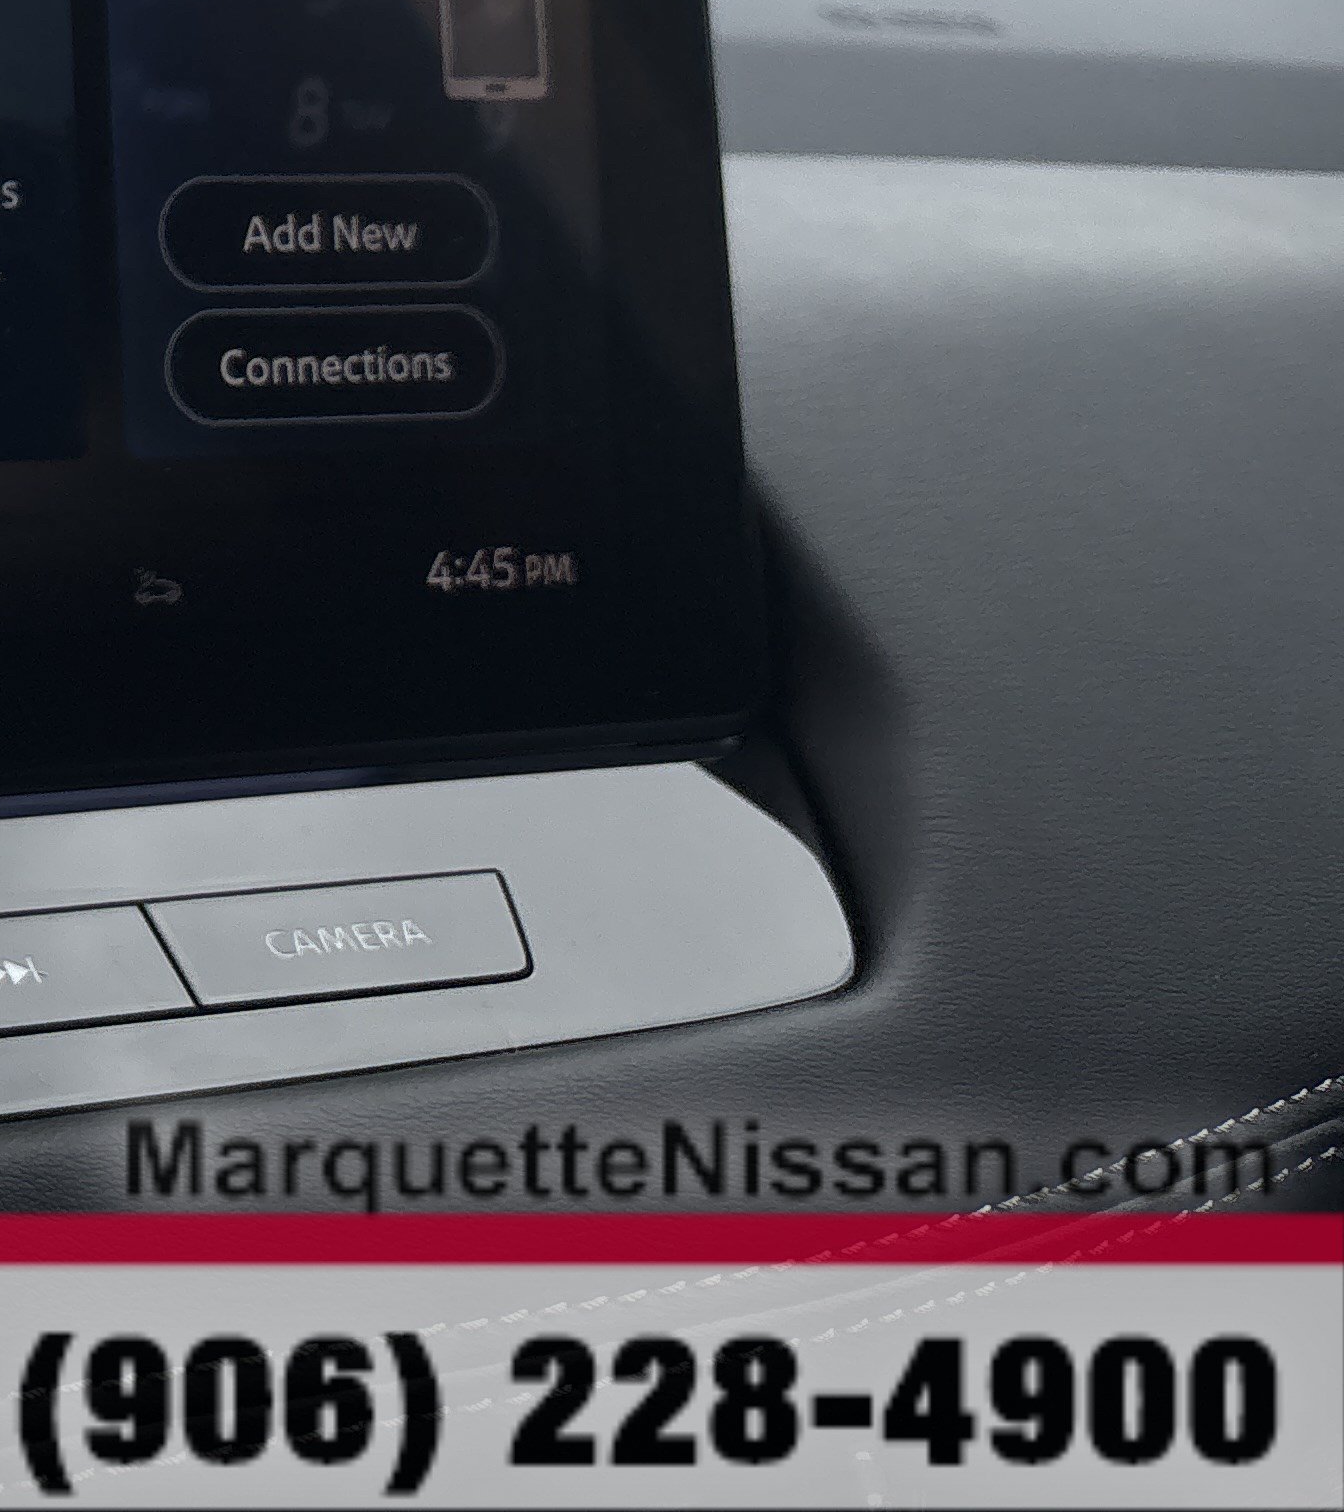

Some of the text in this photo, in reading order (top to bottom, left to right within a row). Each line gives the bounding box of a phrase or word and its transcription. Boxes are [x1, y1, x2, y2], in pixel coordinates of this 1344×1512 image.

[243, 214, 417, 252] Add New
[220, 347, 451, 386] Connections
[426, 546, 579, 591] 4:45 PM
[264, 915, 432, 961] CAMERA
